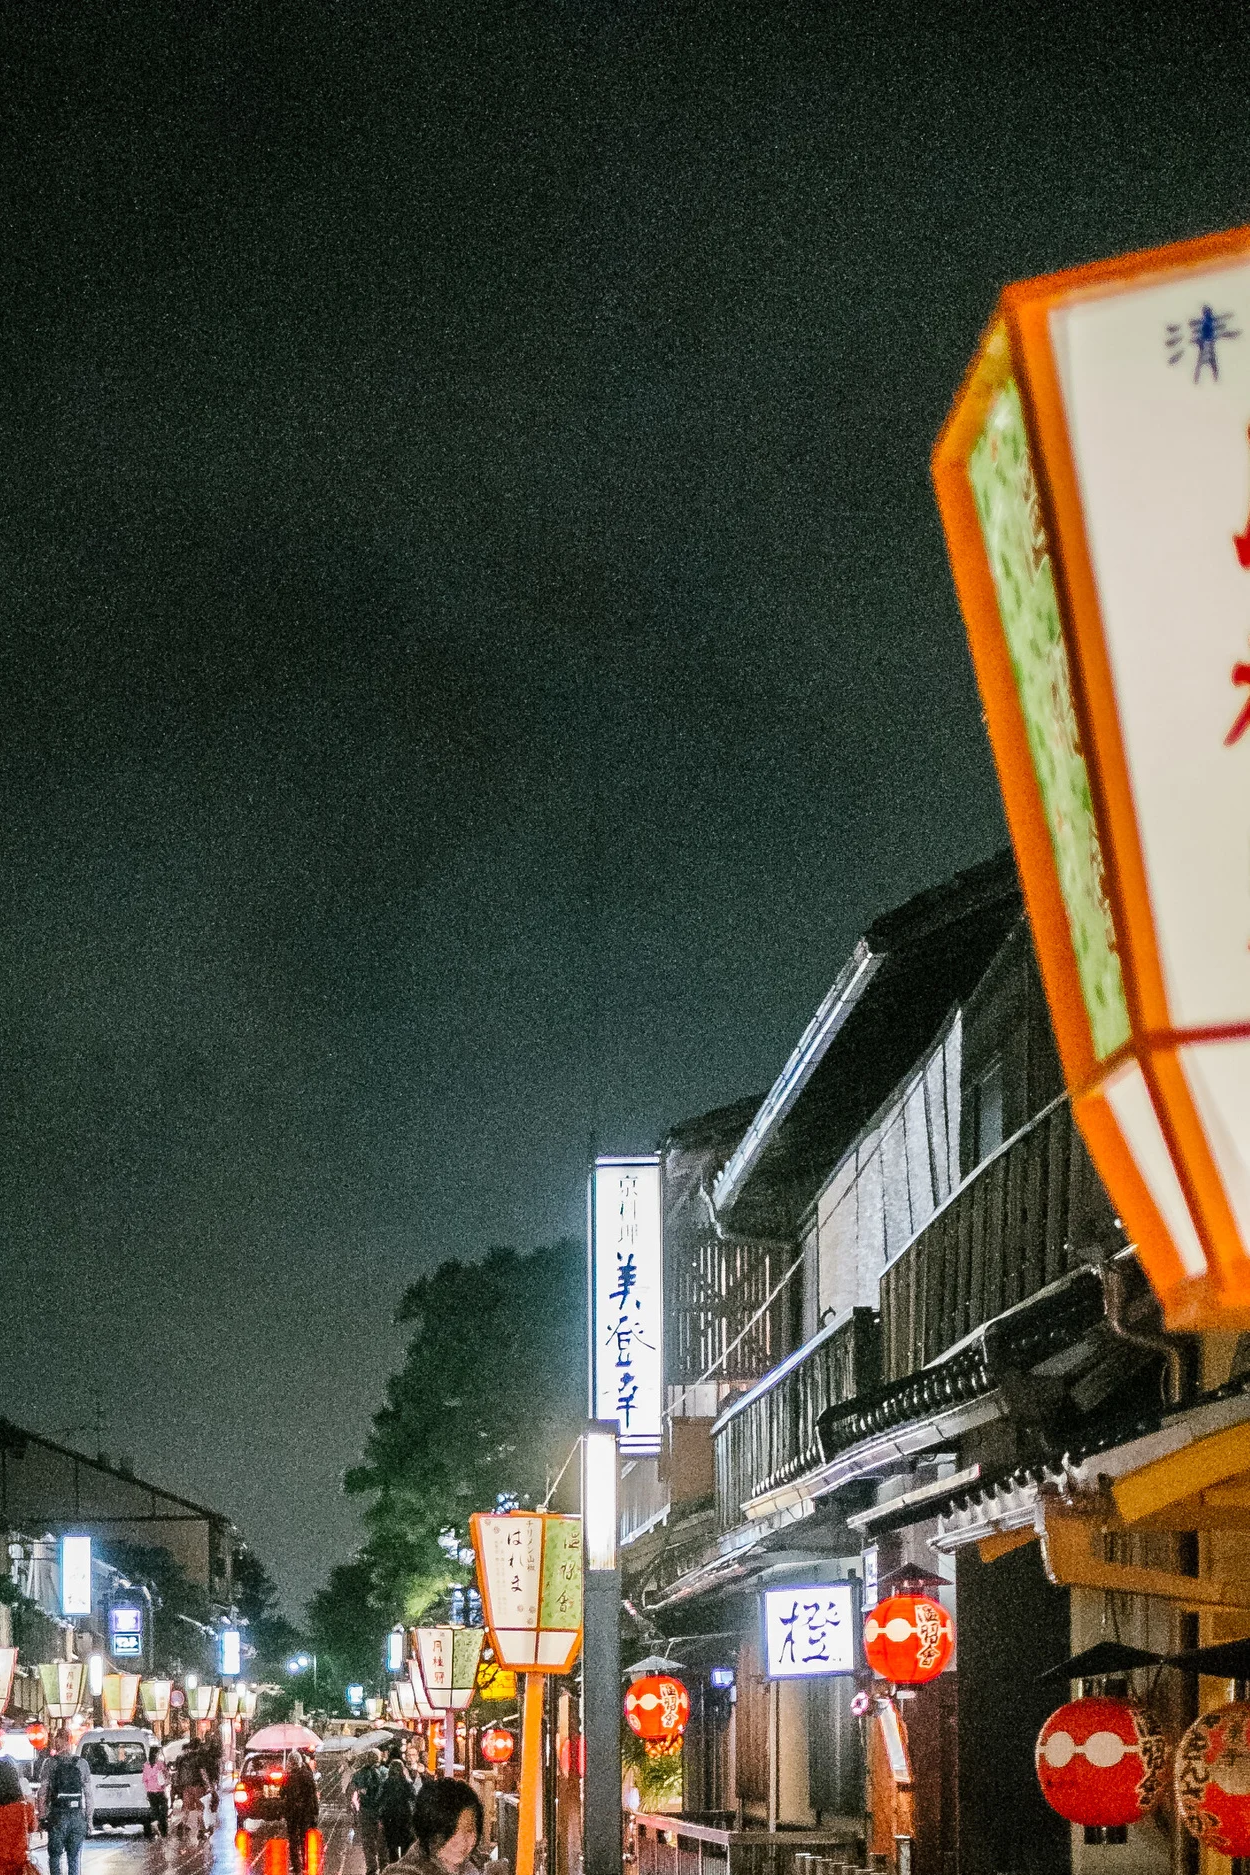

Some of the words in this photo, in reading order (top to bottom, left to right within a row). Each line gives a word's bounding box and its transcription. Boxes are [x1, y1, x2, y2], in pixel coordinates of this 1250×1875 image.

[507, 1531, 524, 1593] はれま
[433, 1640, 445, 1684] 月桂冠
[779, 1601, 841, 1664] 橙
